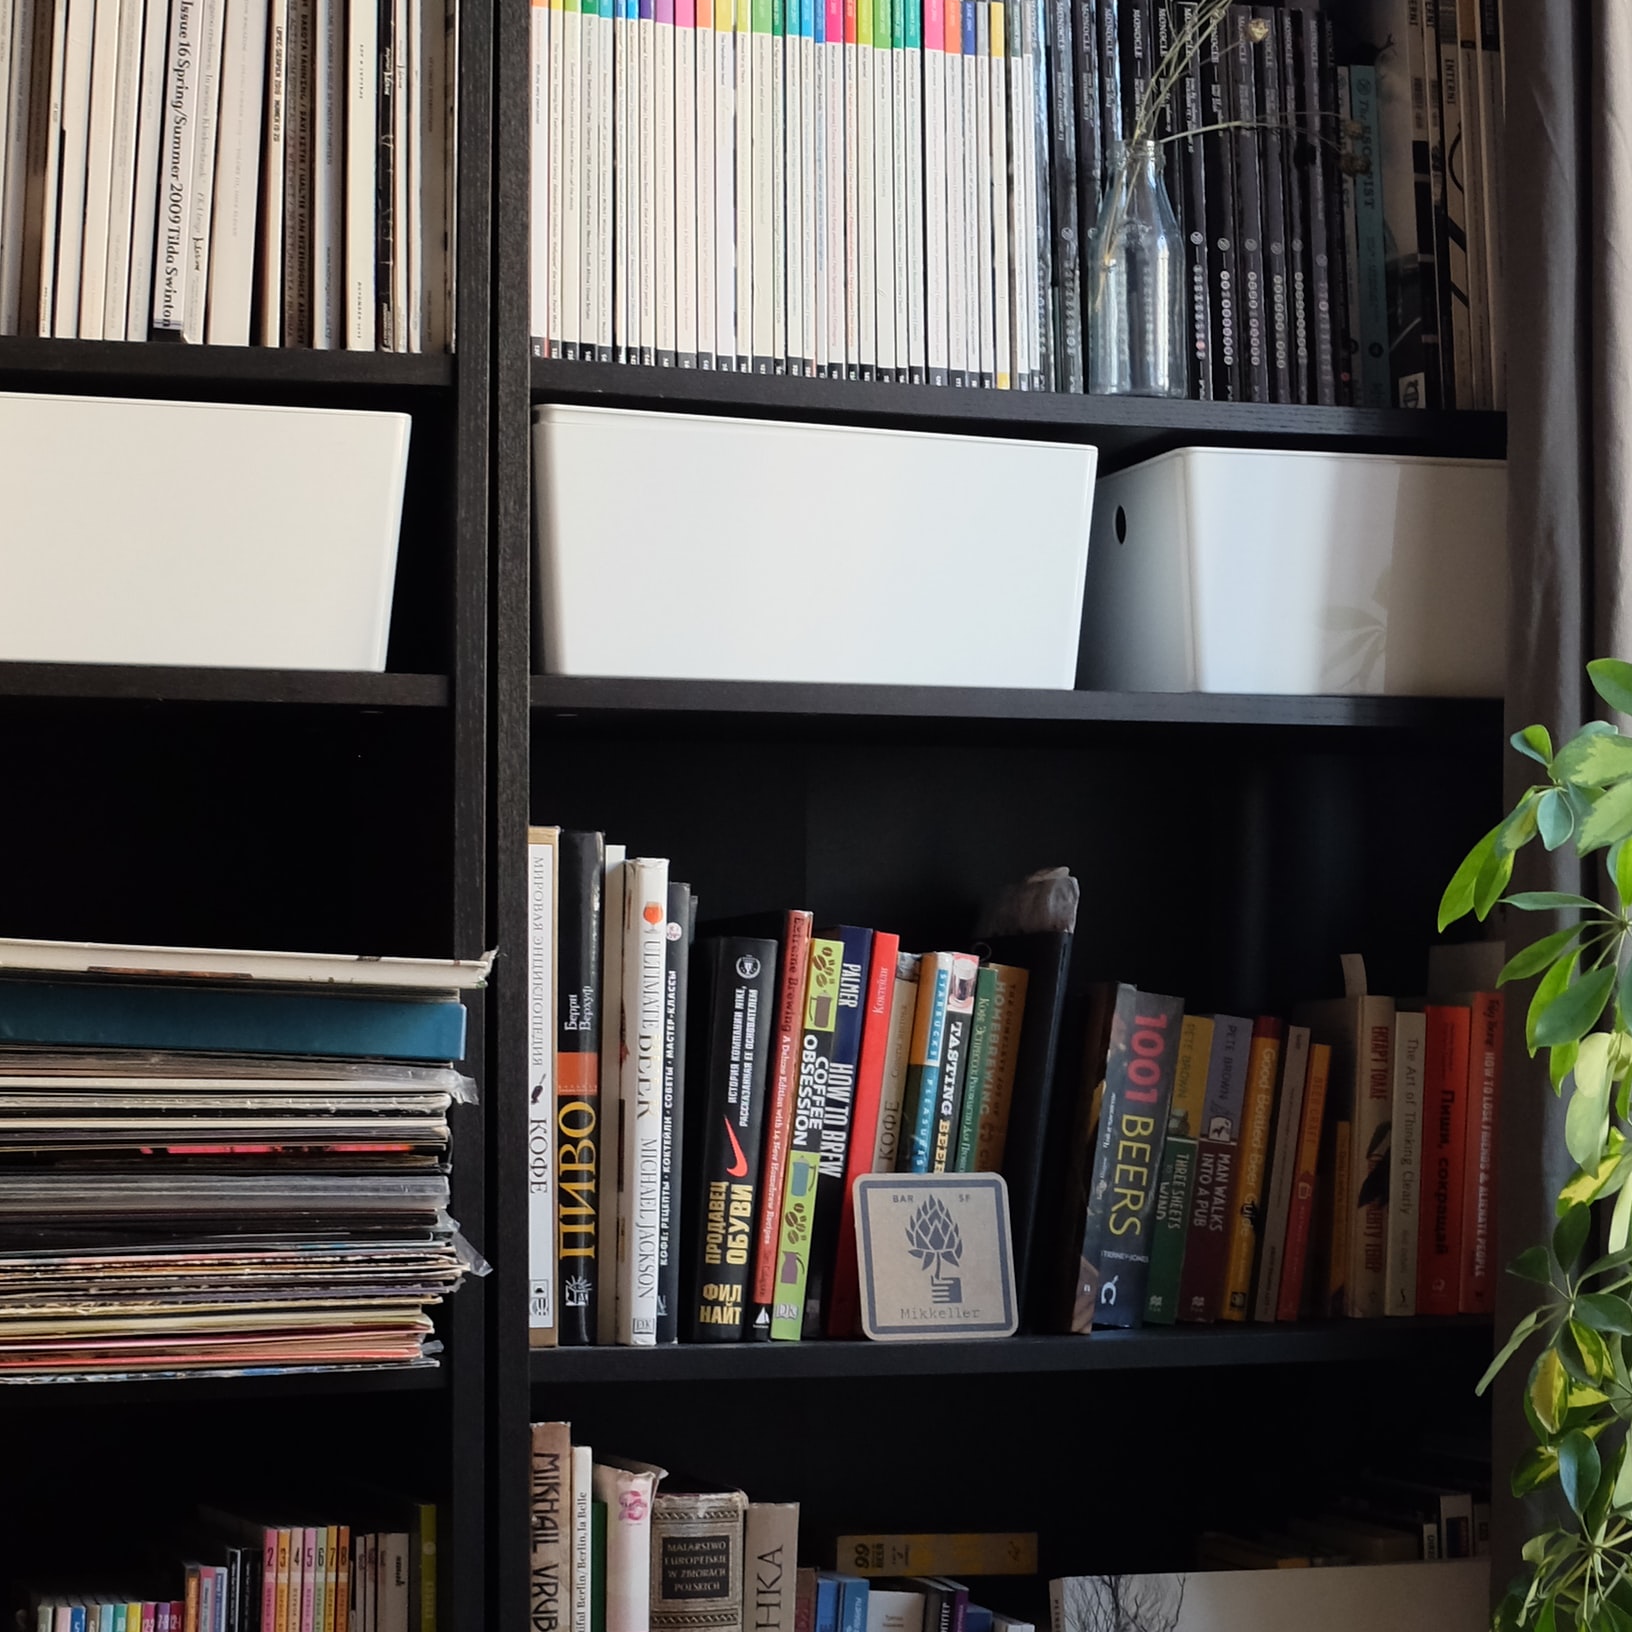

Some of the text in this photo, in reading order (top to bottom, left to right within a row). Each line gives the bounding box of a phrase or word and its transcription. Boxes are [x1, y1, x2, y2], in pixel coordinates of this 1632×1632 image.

[178, 0, 194, 39] Issue
[1081, 2, 1090, 53] MONOCLE
[1132, 8, 1142, 58] MONOCLE
[177, 41, 191, 56] 16
[1445, 59, 1456, 104] INTERNI
[169, 57, 190, 181] Spring/Summer
[1361, 125, 1375, 209] ESCPIST
[167, 183, 184, 225] 2009
[164, 226, 181, 264] Tilda
[161, 266, 178, 327] Swinton
[790, 917, 804, 972] Extreme
[579, 985, 594, 1030] Верхуф
[782, 977, 798, 1031] Brewing
[838, 963, 861, 1007] PALMER
[872, 967, 889, 1013] Коктейли
[530, 856, 548, 1193] МИРОВАЯ ЭНЦИКЛОПЕДИЯ КОФЕ
[564, 994, 579, 1030] Берри
[745, 989, 758, 1049] ОСНОВАТЕЛЕМ
[929, 973, 946, 1057] STARBUCKS
[729, 1011, 742, 1061] КОМПАНИИ
[980, 981, 1006, 1116] HOMEBREWING
[998, 1009, 1014, 1073] COMPLETE
[778, 1045, 790, 1074] Deluxe
[1177, 1023, 1196, 1099] PETE BROWN
[1219, 1024, 1237, 1100] PETE BROWN
[1482, 1052, 1494, 1077] HOW
[663, 1065, 675, 1108] СОВЕТЫ
[728, 1063, 739, 1103] ИСТОРИЯ
[739, 1062, 753, 1127] РАССКАЗАННАЯ
[775, 1076, 787, 1105] Edition
[793, 1034, 817, 1145] OBSESSION
[808, 1056, 829, 1130] COFFEE
[933, 1021, 962, 1173] TASTING BEER
[996, 1076, 1005, 1098] JOY
[1482, 1080, 1494, 1094] TO
[637, 940, 661, 1298] ULTIMATE BEER MICHAEL JACKSON
[773, 1108, 784, 1128] with
[818, 1062, 854, 1178] HOW TO BREW
[879, 1101, 899, 1161] КОФЕ
[1108, 1014, 1167, 1236] 1001 BEERS
[1304, 1076, 1323, 1144] BEER CRAFT
[1398, 1038, 1418, 1214] The Art of Thinking Clearly
[1480, 1095, 1493, 1122] LOSE
[662, 1116, 673, 1173] КОКТЕЙЛИ
[770, 1141, 781, 1161] New
[1240, 1048, 1276, 1236] Good Bottled Beer Guide
[1478, 1125, 1492, 1168] FRIENDS
[558, 1100, 597, 1260] ПИВО
[765, 1162, 780, 1205] Homebrew
[1167, 1153, 1190, 1229] THREE SHEETS
[1193, 1152, 1214, 1227] INTO A PUB
[1208, 1152, 1232, 1232] MAN WALKS
[1433, 1090, 1455, 1254] Пиши, сокращай
[660, 1181, 672, 1228] РЕЦЕПТЫ
[892, 1194, 971, 1203] BAR SF
[1475, 1186, 1489, 1236] ALIENATE
[705, 1181, 729, 1265] ПРОДАВЕЦ
[726, 1183, 753, 1265] ОБУВИ
[762, 1208, 774, 1244] Recipes
[660, 1231, 671, 1265] КОФЕ:
[1474, 1238, 1487, 1276] PEOPLE
[699, 1305, 741, 1325] НАЙТ
[702, 1283, 742, 1303] ФИЛ
[900, 1307, 980, 1320] Mikkeller
[531, 1451, 560, 1553] MIKHAIL
[576, 1491, 588, 1518] Belle
[267, 1547, 274, 1567] 2
[280, 1547, 286, 1567] 3
[294, 1547, 300, 1566] 4
[306, 1547, 313, 1567] 5
[318, 1547, 325, 1567] 6
[329, 1547, 336, 1567] 7
[341, 1546, 347, 1565] 8
[854, 1543, 869, 1568] 99
